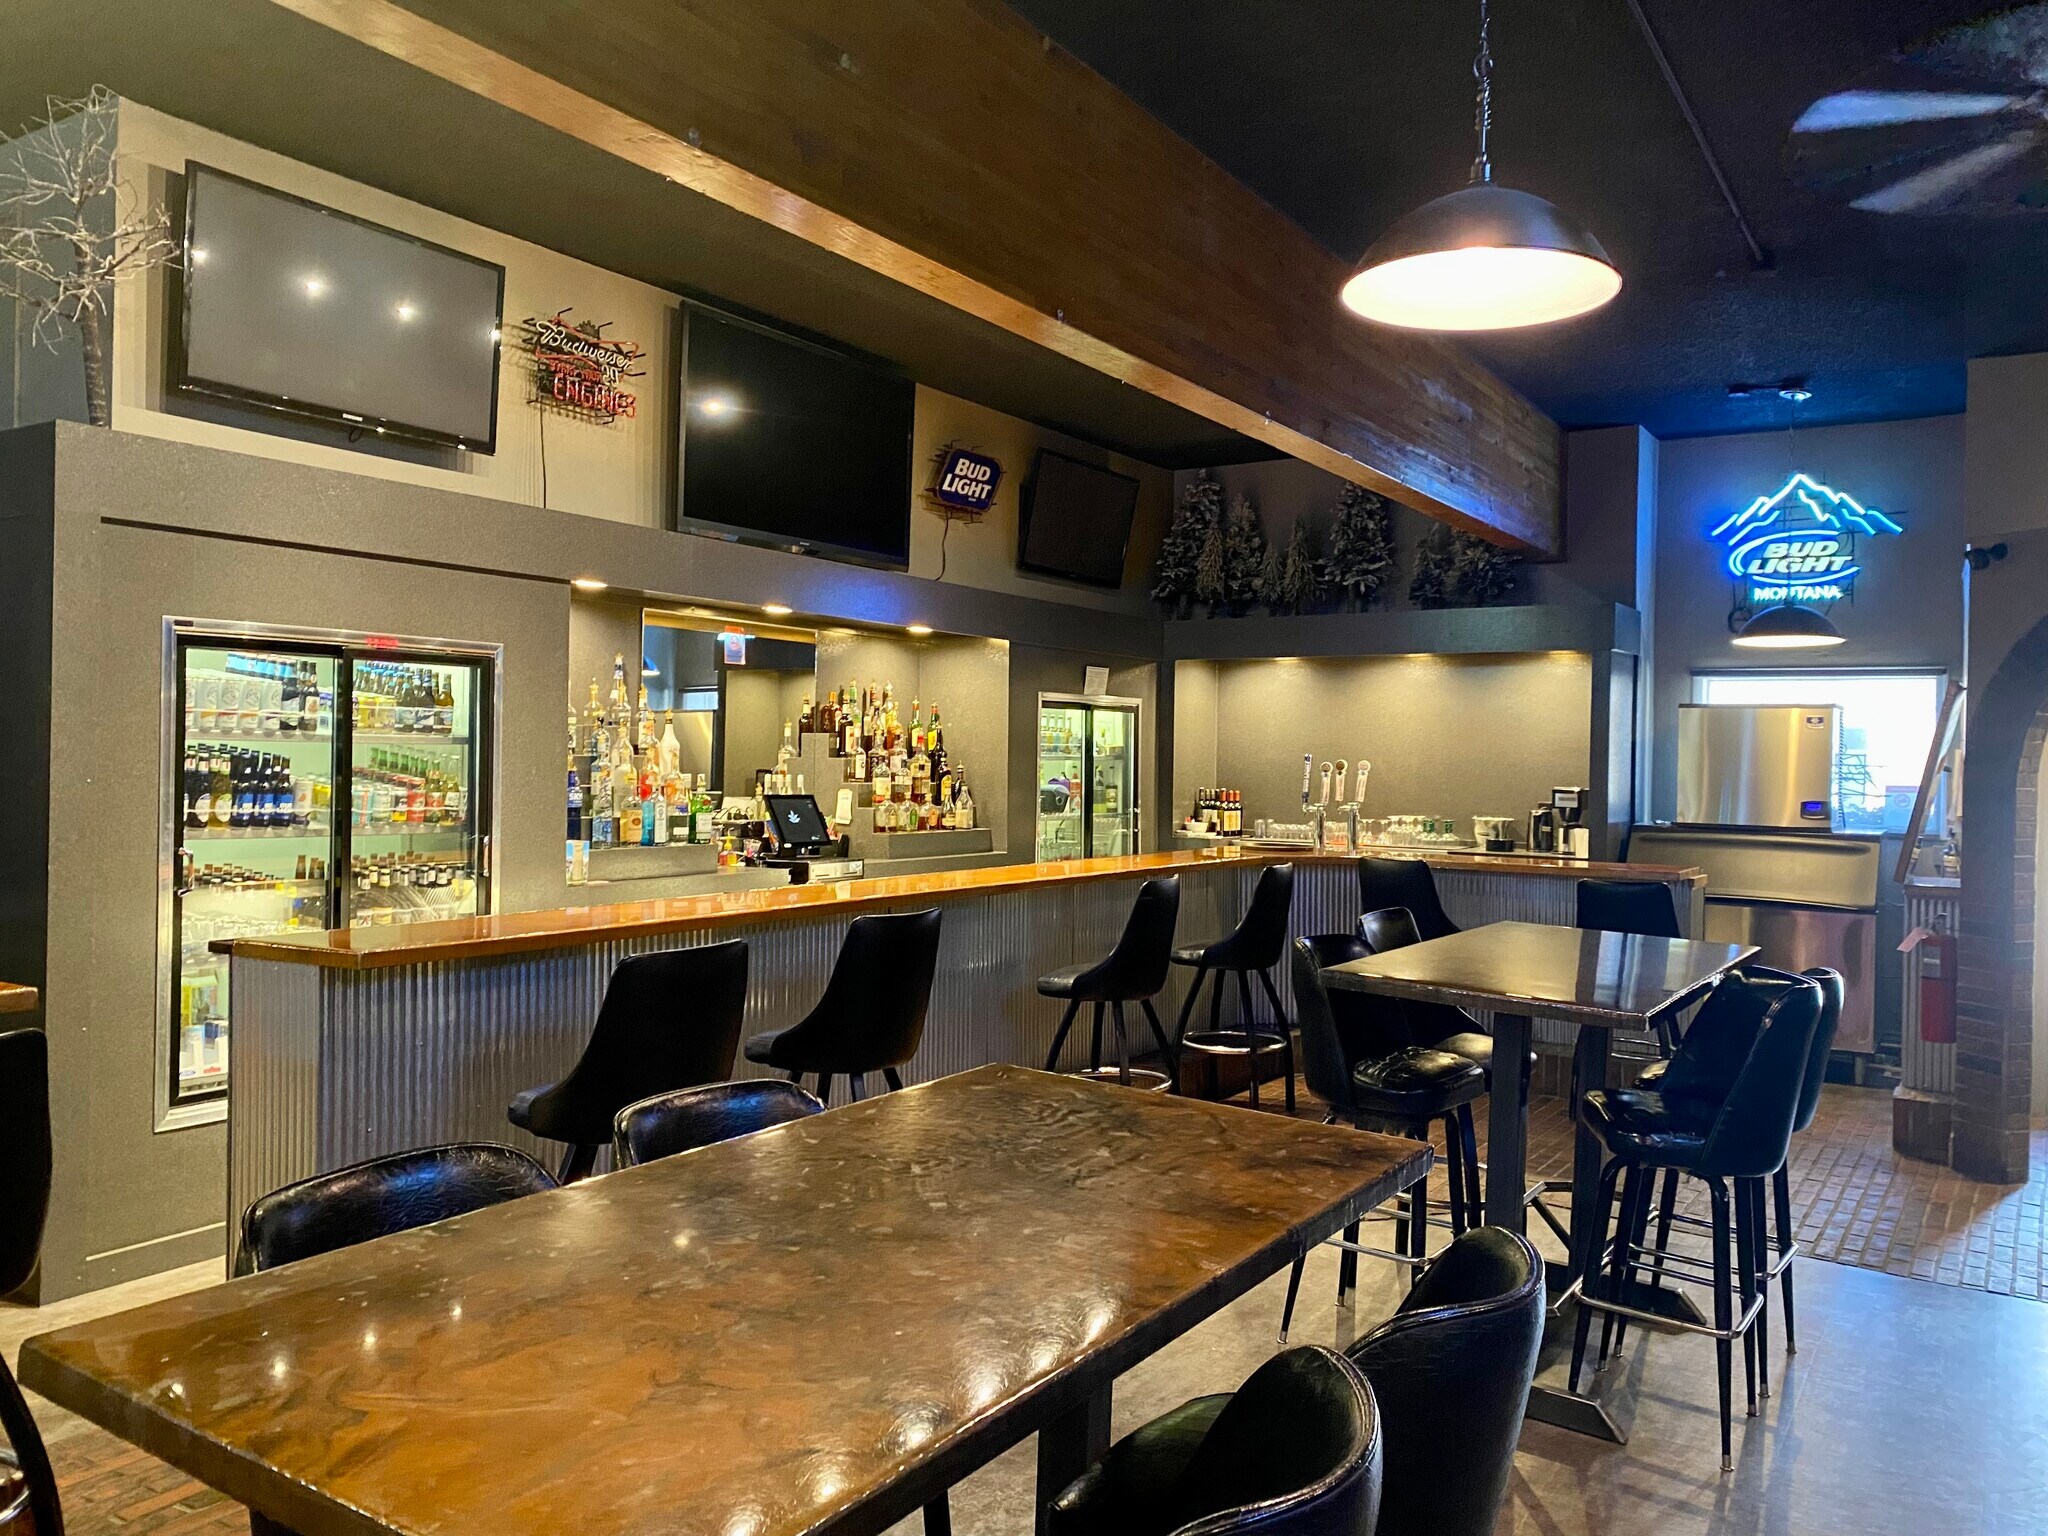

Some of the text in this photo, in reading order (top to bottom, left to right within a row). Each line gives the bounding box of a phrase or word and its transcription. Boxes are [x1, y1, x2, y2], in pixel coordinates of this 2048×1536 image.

[536, 321, 633, 370] Budweiser
[554, 373, 635, 418] ENGINES
[955, 458, 991, 481] BUD
[942, 474, 992, 499] LIGHT
[1763, 541, 1840, 558] BUD
[1746, 556, 1853, 574] LIGHT
[1754, 585, 1843, 601] MONTANA
